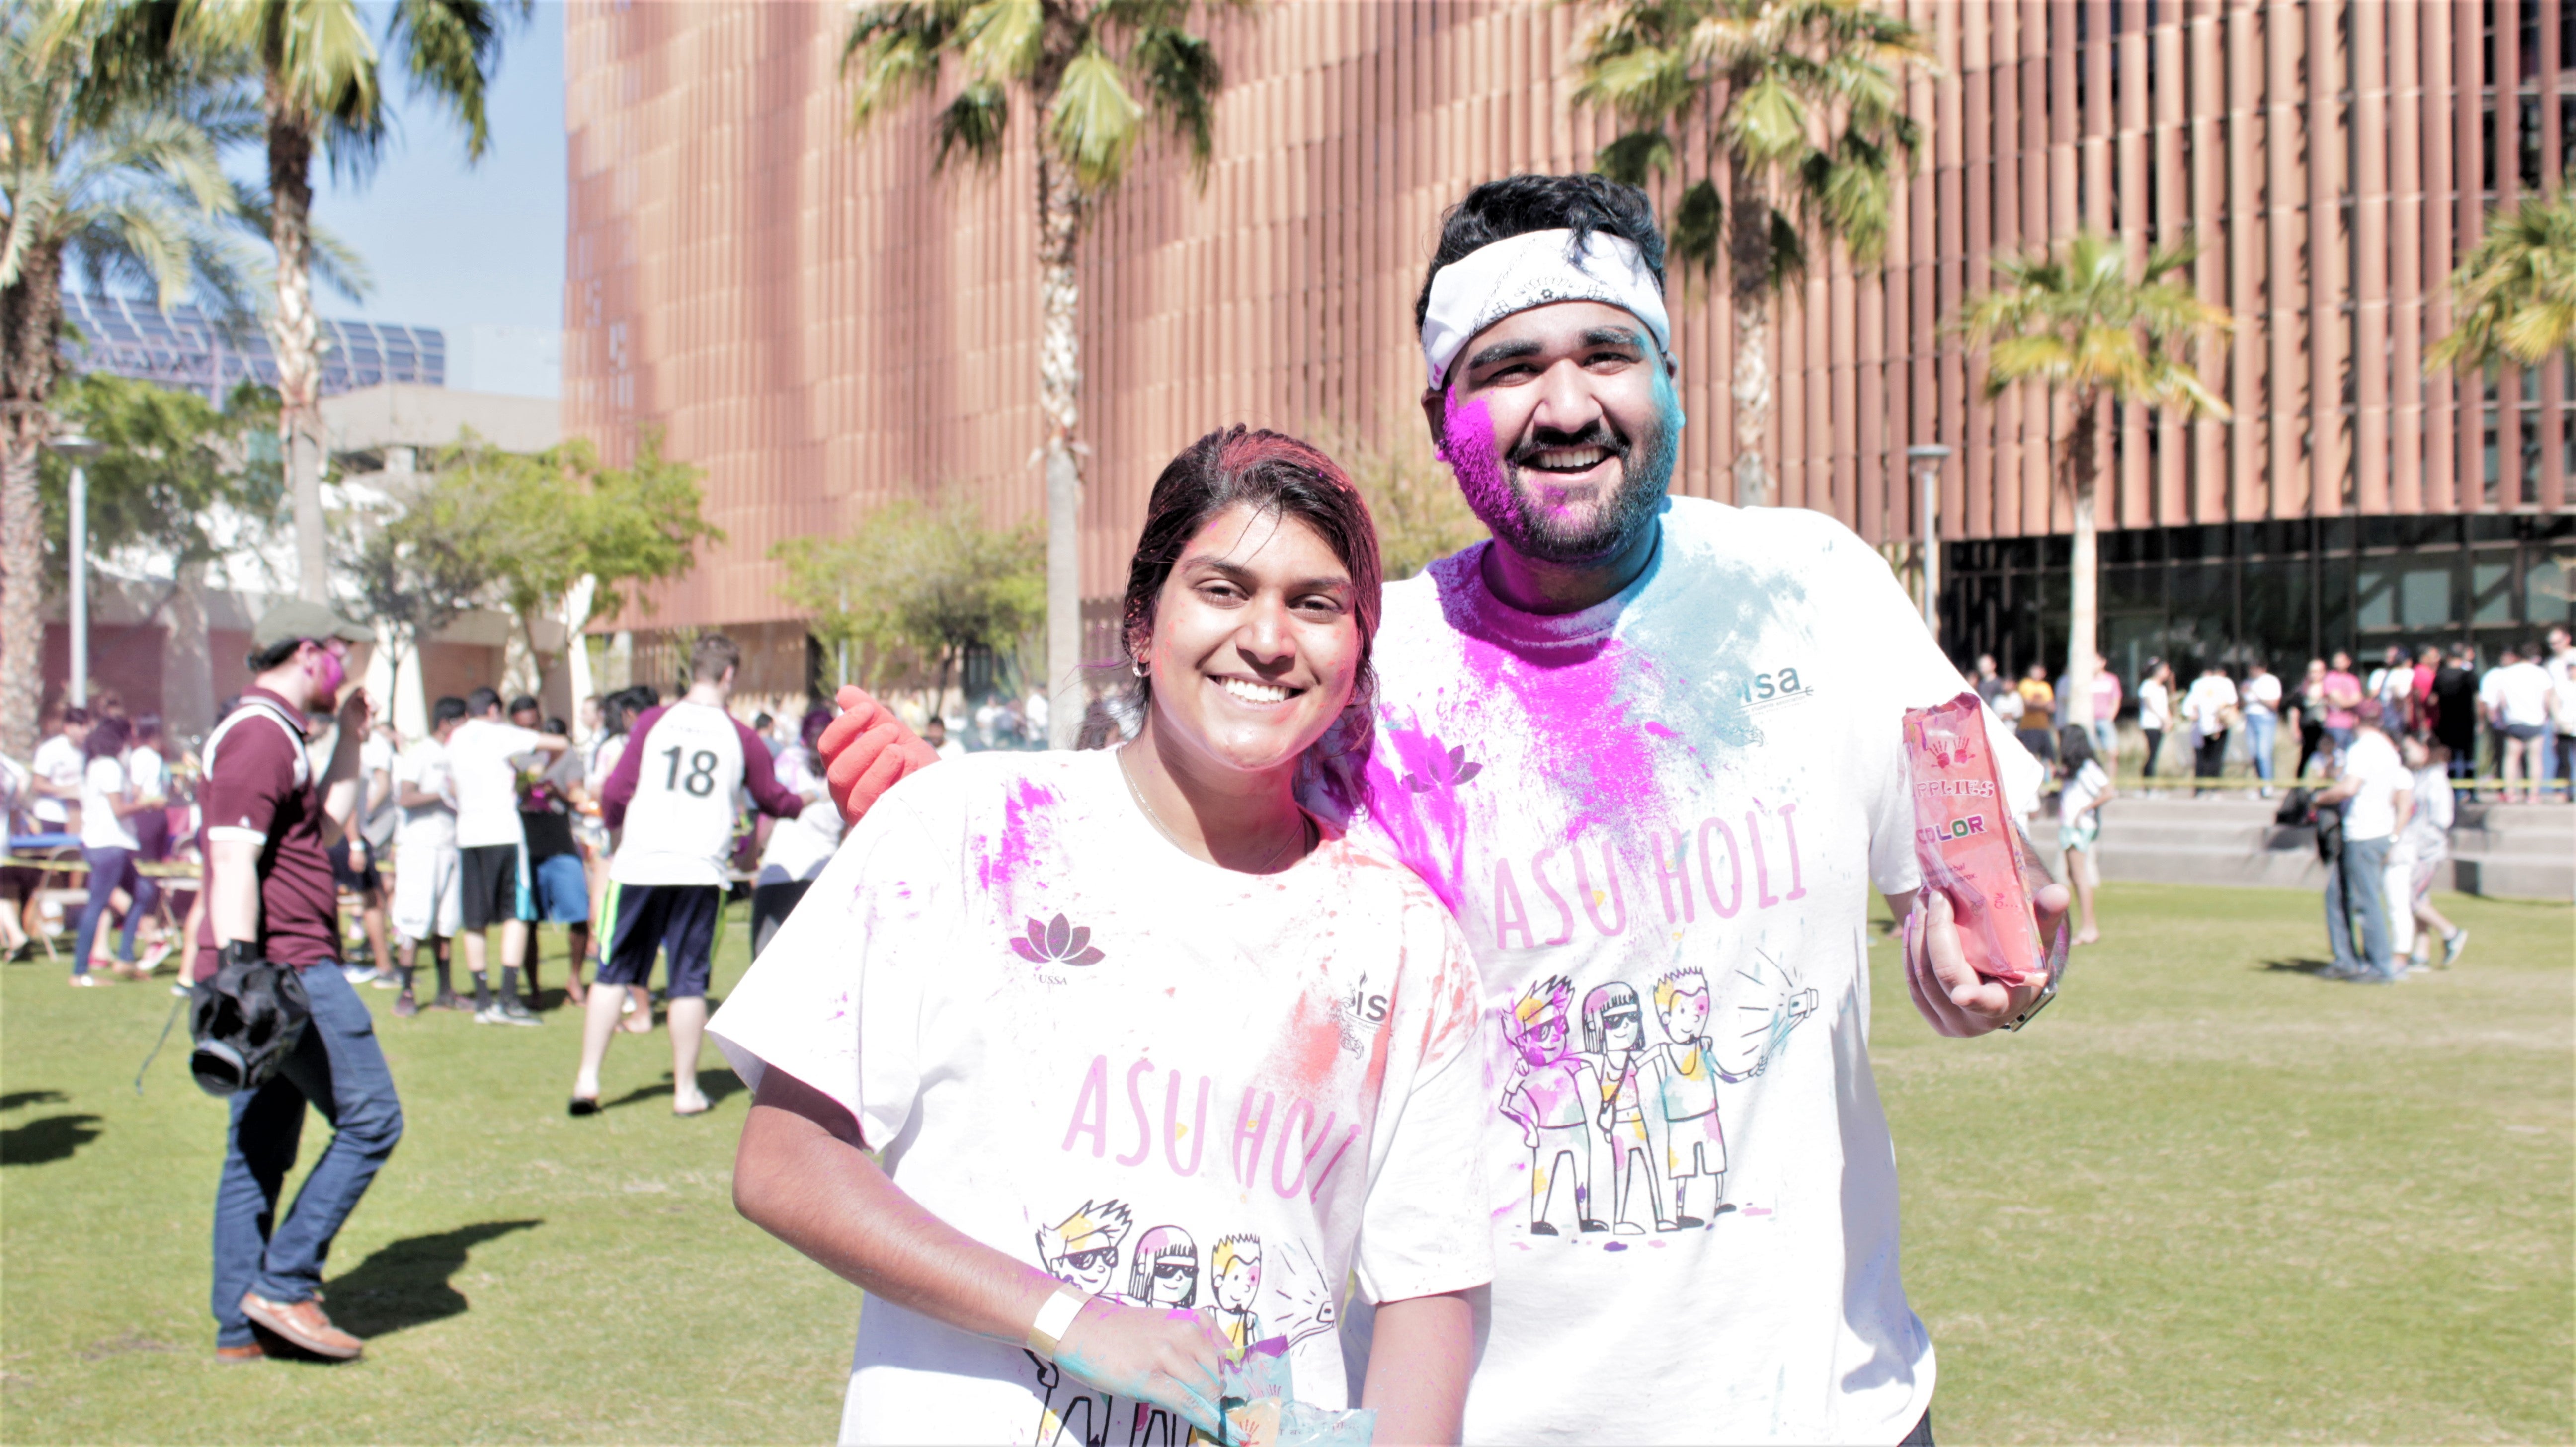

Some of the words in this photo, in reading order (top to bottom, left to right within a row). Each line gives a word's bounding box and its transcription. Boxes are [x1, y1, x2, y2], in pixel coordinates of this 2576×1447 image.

[661, 745, 719, 798] 18
[1915, 779, 1995, 798] PPLIES
[1916, 814, 1987, 844] COLOR
[1494, 840, 1627, 950] ASU
[1650, 803, 1807, 925] HOLI
[1039, 974, 1067, 985] USSA
[1356, 990, 1388, 1022] is
[1061, 1054, 1211, 1177] ASU
